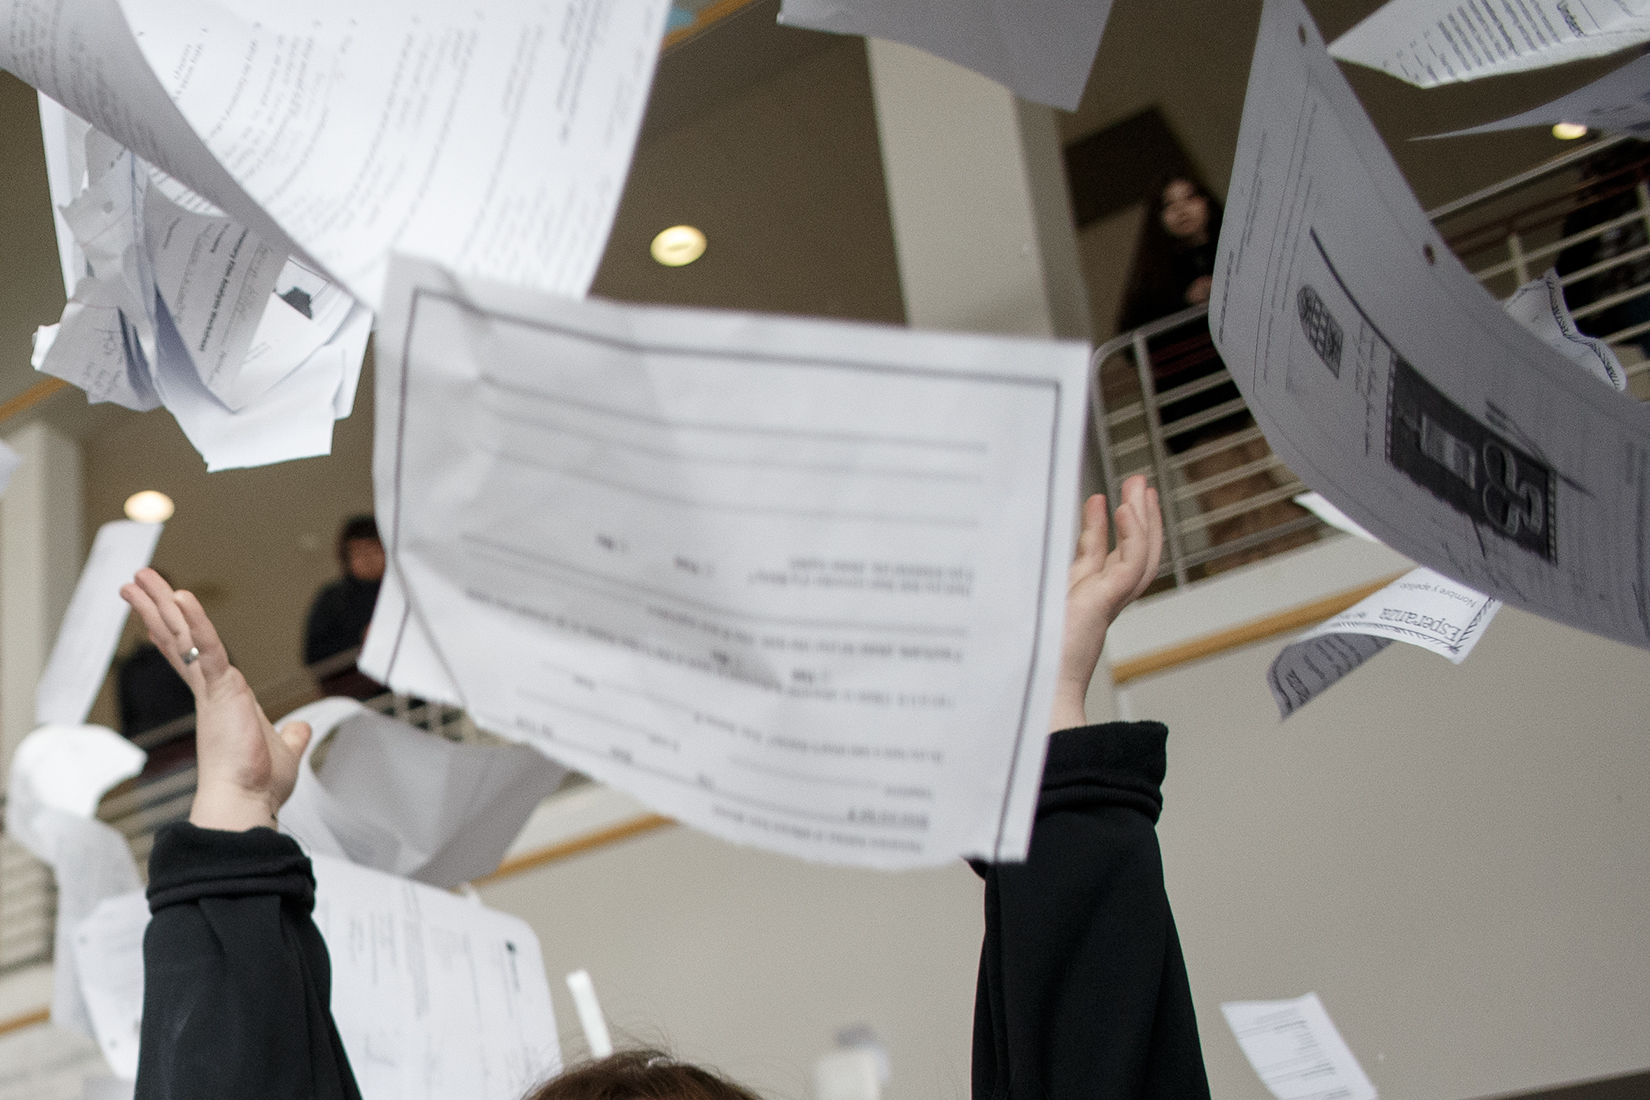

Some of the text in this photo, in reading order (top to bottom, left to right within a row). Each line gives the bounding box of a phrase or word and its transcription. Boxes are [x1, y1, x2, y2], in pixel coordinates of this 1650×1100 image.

[200, 311, 217, 351] Worksheet
[1439, 589, 1477, 608] Nombre
[1378, 607, 1462, 642] Esperanza
